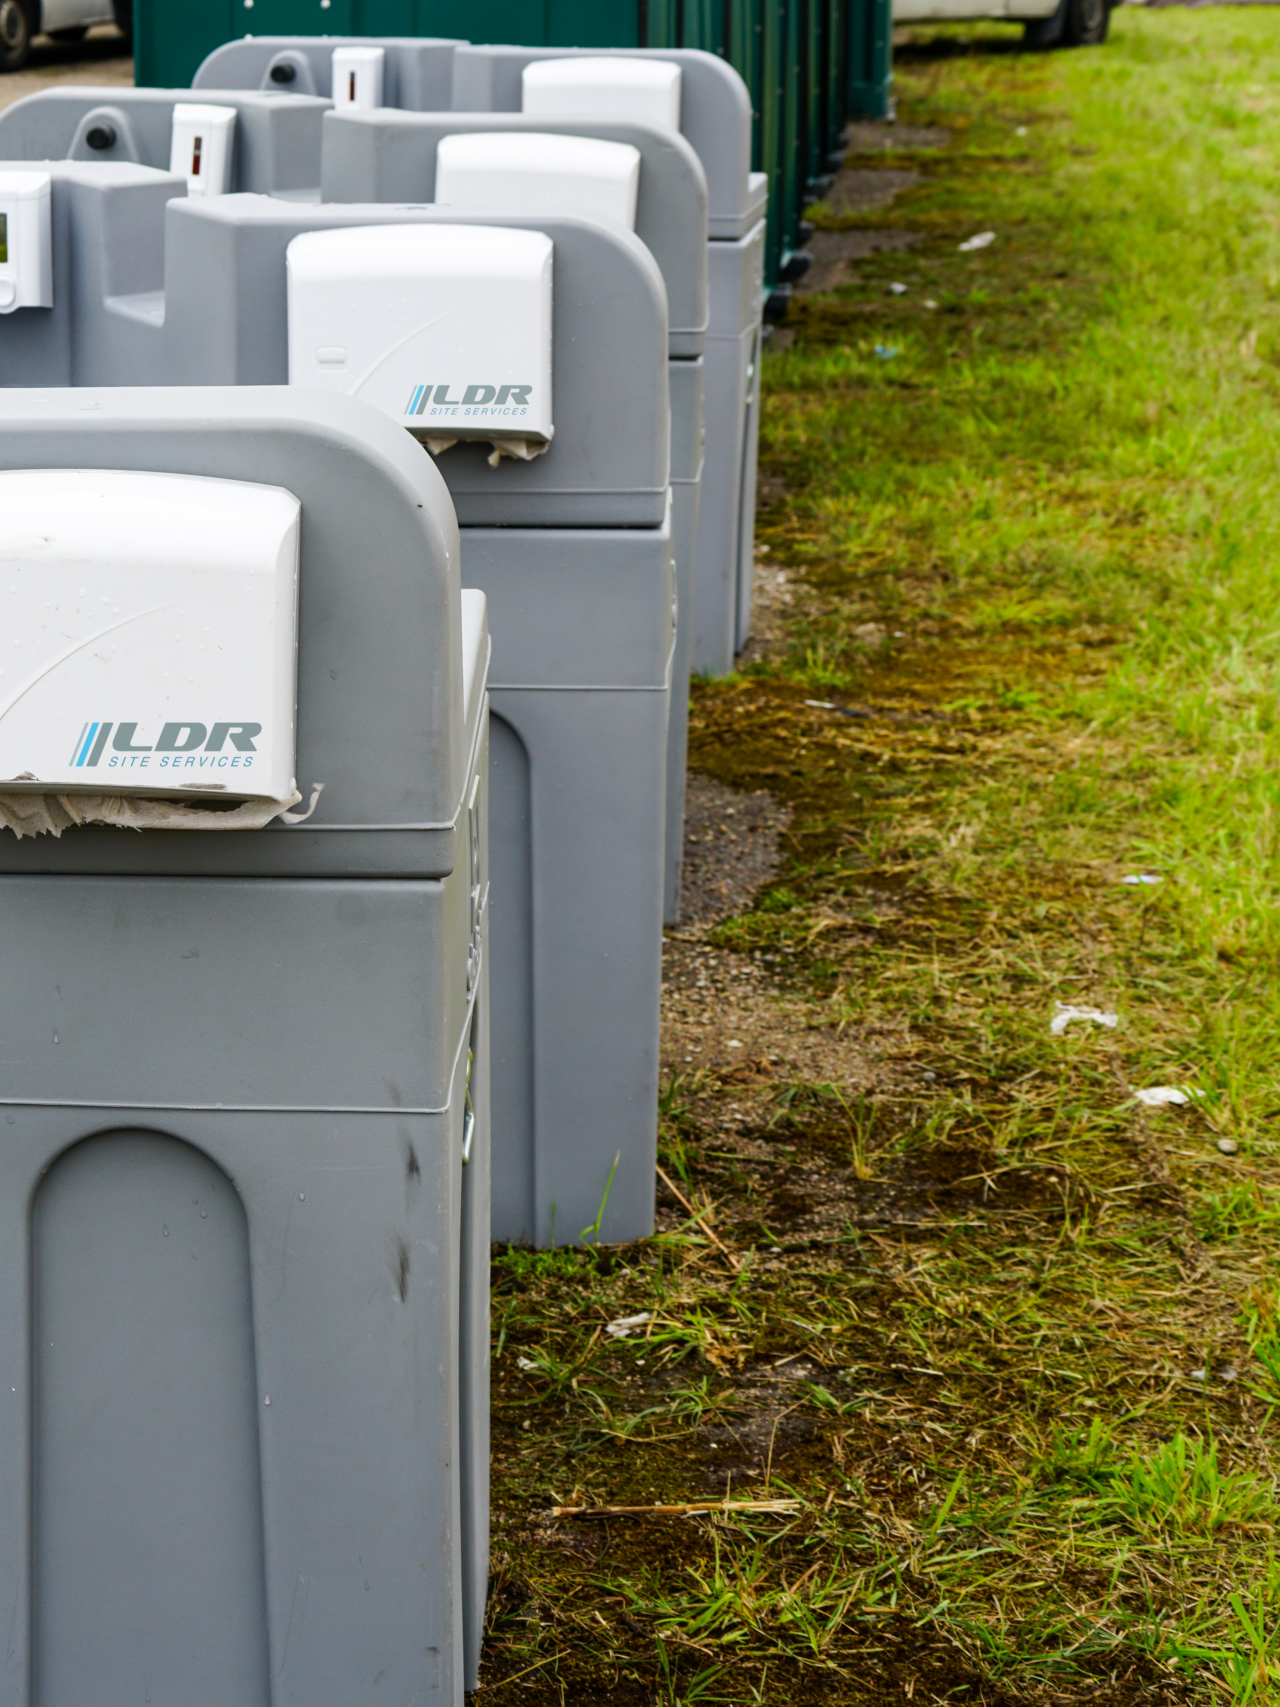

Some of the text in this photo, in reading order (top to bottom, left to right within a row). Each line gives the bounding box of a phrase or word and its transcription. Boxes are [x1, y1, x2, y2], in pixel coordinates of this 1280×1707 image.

[432, 384, 533, 405] LDR
[430, 407, 528, 416] SITE SERVICES
[112, 721, 263, 752] LDR
[108, 756, 254, 768] SITE SERVICES
